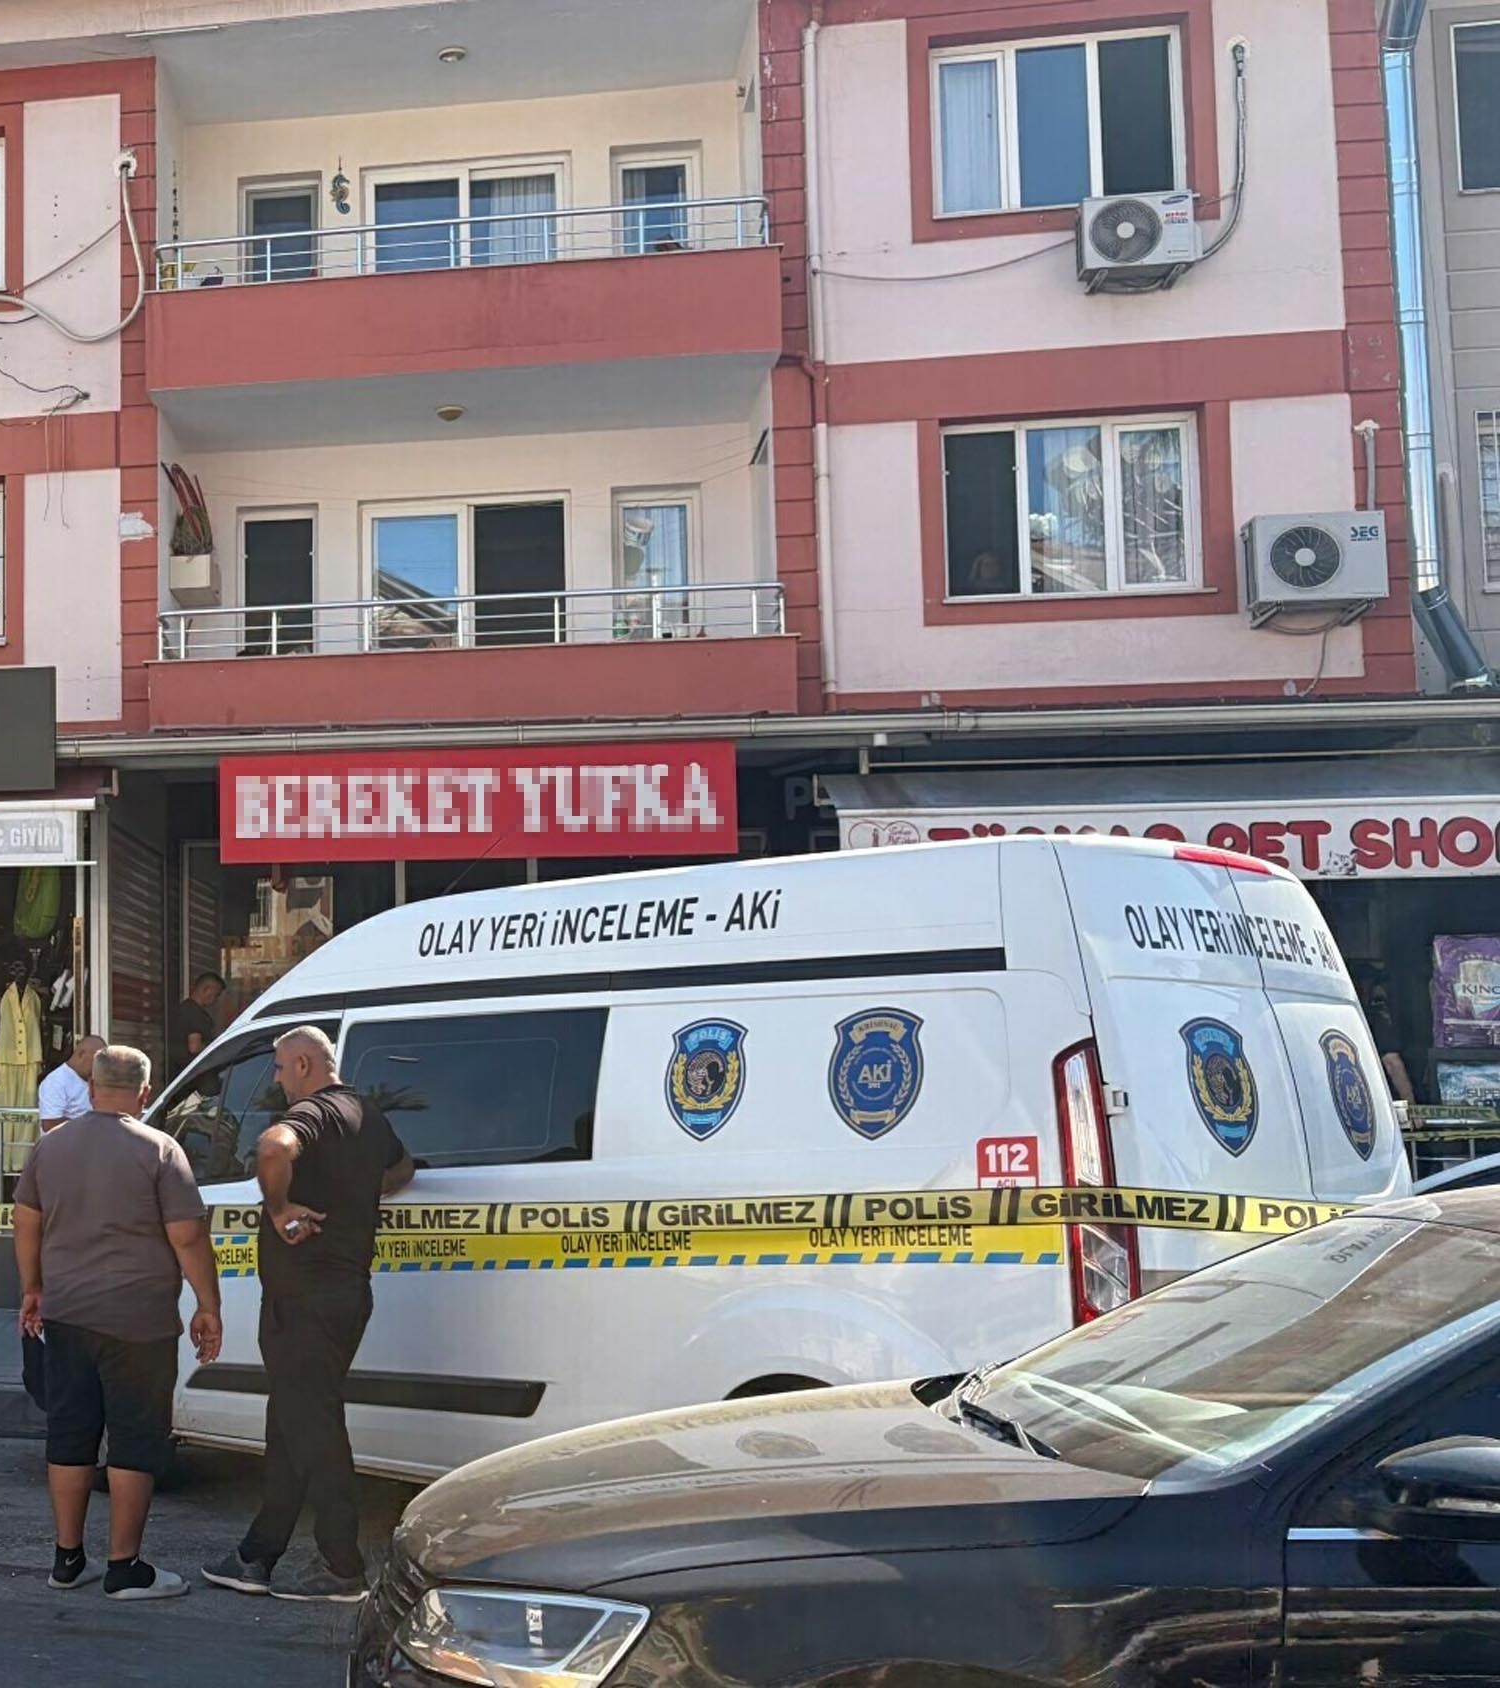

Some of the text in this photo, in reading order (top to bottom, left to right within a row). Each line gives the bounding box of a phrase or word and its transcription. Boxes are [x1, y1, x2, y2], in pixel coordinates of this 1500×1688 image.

[1350, 525, 1379, 538] SEG
[235, 769, 499, 838] BEREKET
[514, 763, 723, 832] YUFKA
[10, 824, 60, 846] GİYİM
[1350, 817, 1500, 869] SHO
[418, 918, 484, 957] OLAY
[490, 912, 547, 951] YERİ
[550, 897, 699, 946] İNCELEME
[724, 889, 782, 932] AKİ
[1124, 904, 1185, 951] OLAY
[1181, 907, 1233, 954] YERİ
[1226, 912, 1312, 965] İNCELEME
[858, 1060, 892, 1083] AKİ
[985, 1143, 1029, 1172] 112
[379, 1209, 480, 1230] RİLMEZ
[520, 1207, 610, 1228] POLİS
[657, 1202, 816, 1227] GİRİLMEZ
[864, 1196, 972, 1220] POLİS
[1031, 1192, 1210, 1223] GİRİLMEZ
[561, 1232, 692, 1253] OLAY YERİ İNCELEME
[809, 1227, 847, 1247] OLAY
[889, 1225, 973, 1246] İNCELEME
[215, 1248, 253, 1265] NCELEME
[388, 1240, 411, 1257] YERİ
[413, 1239, 465, 1257] İNCELEME
